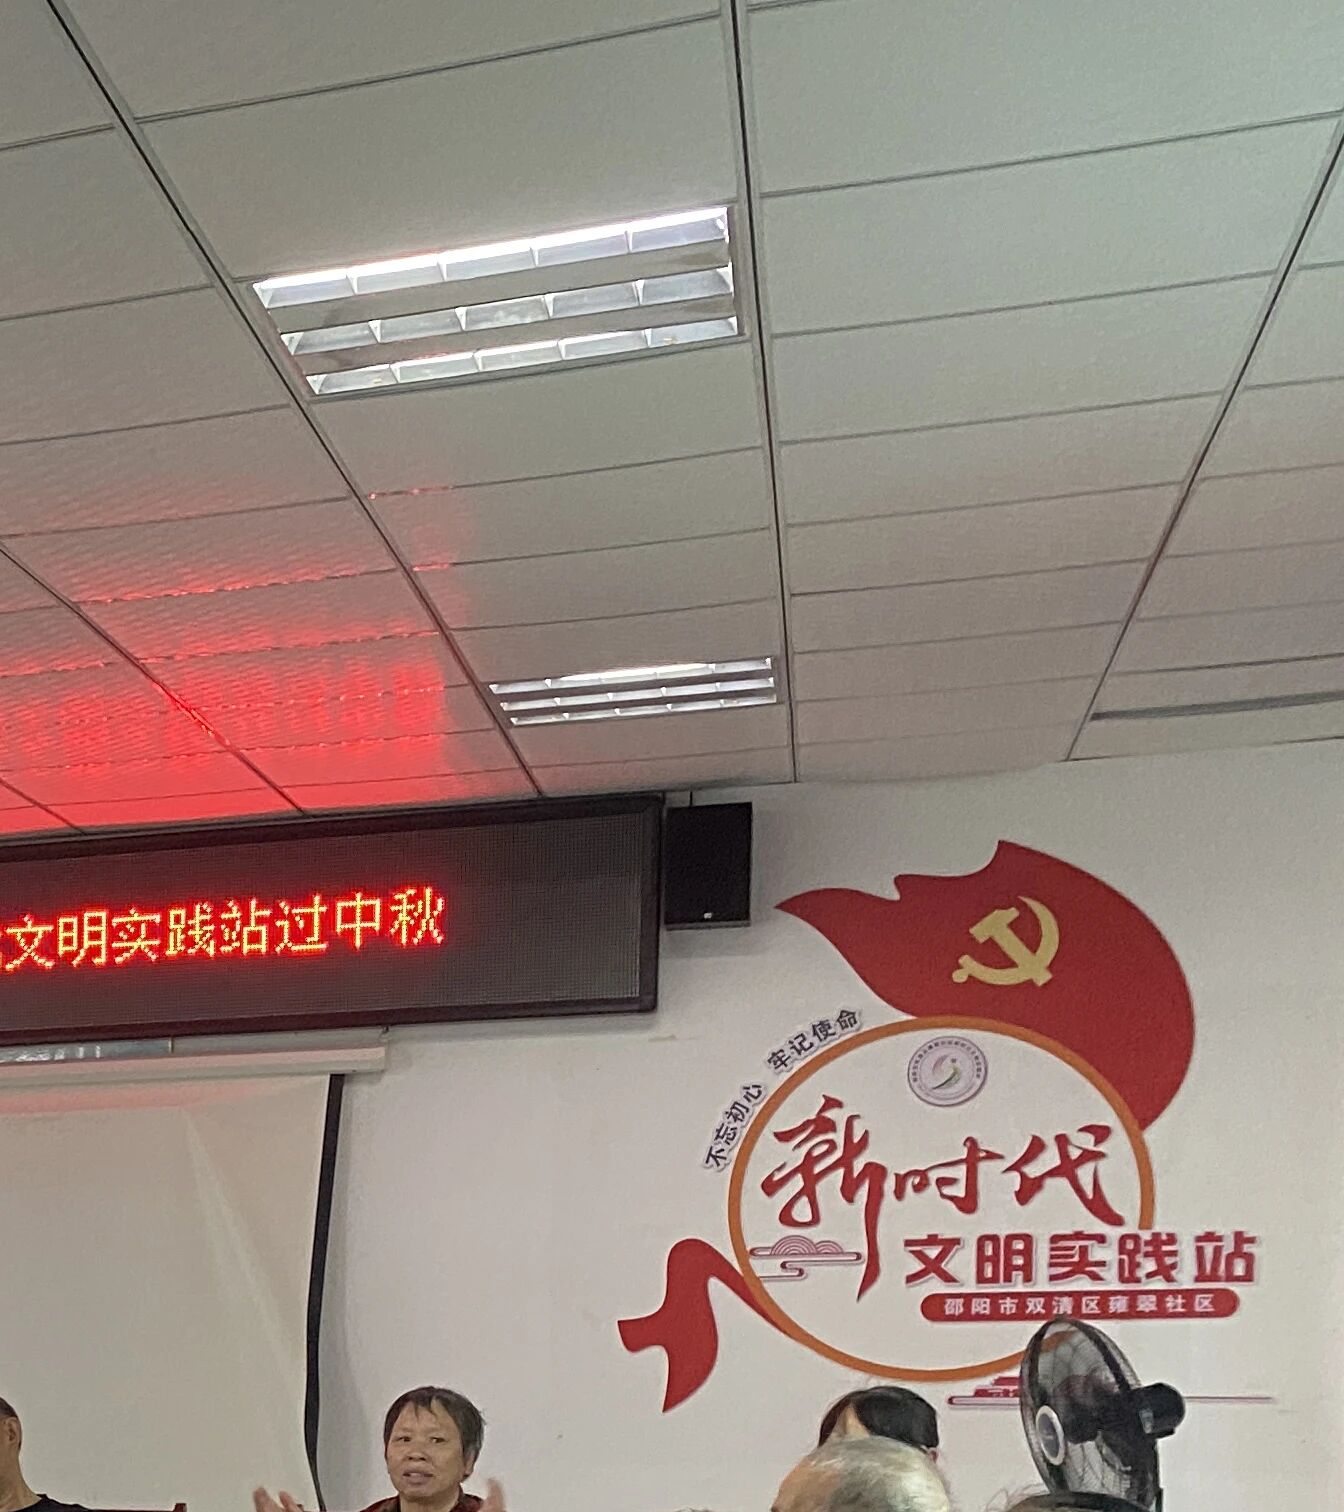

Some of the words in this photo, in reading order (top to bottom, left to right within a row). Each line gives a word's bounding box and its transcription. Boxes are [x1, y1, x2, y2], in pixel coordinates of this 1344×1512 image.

[705, 1083, 762, 1167] 不忘初心
[767, 1009, 859, 1070] 牢记使命
[761, 1094, 1125, 1301] 新时代
[903, 1230, 1258, 1286] 文明实践站
[943, 1294, 1215, 1316] 邵阳市双清区雍翠社区
